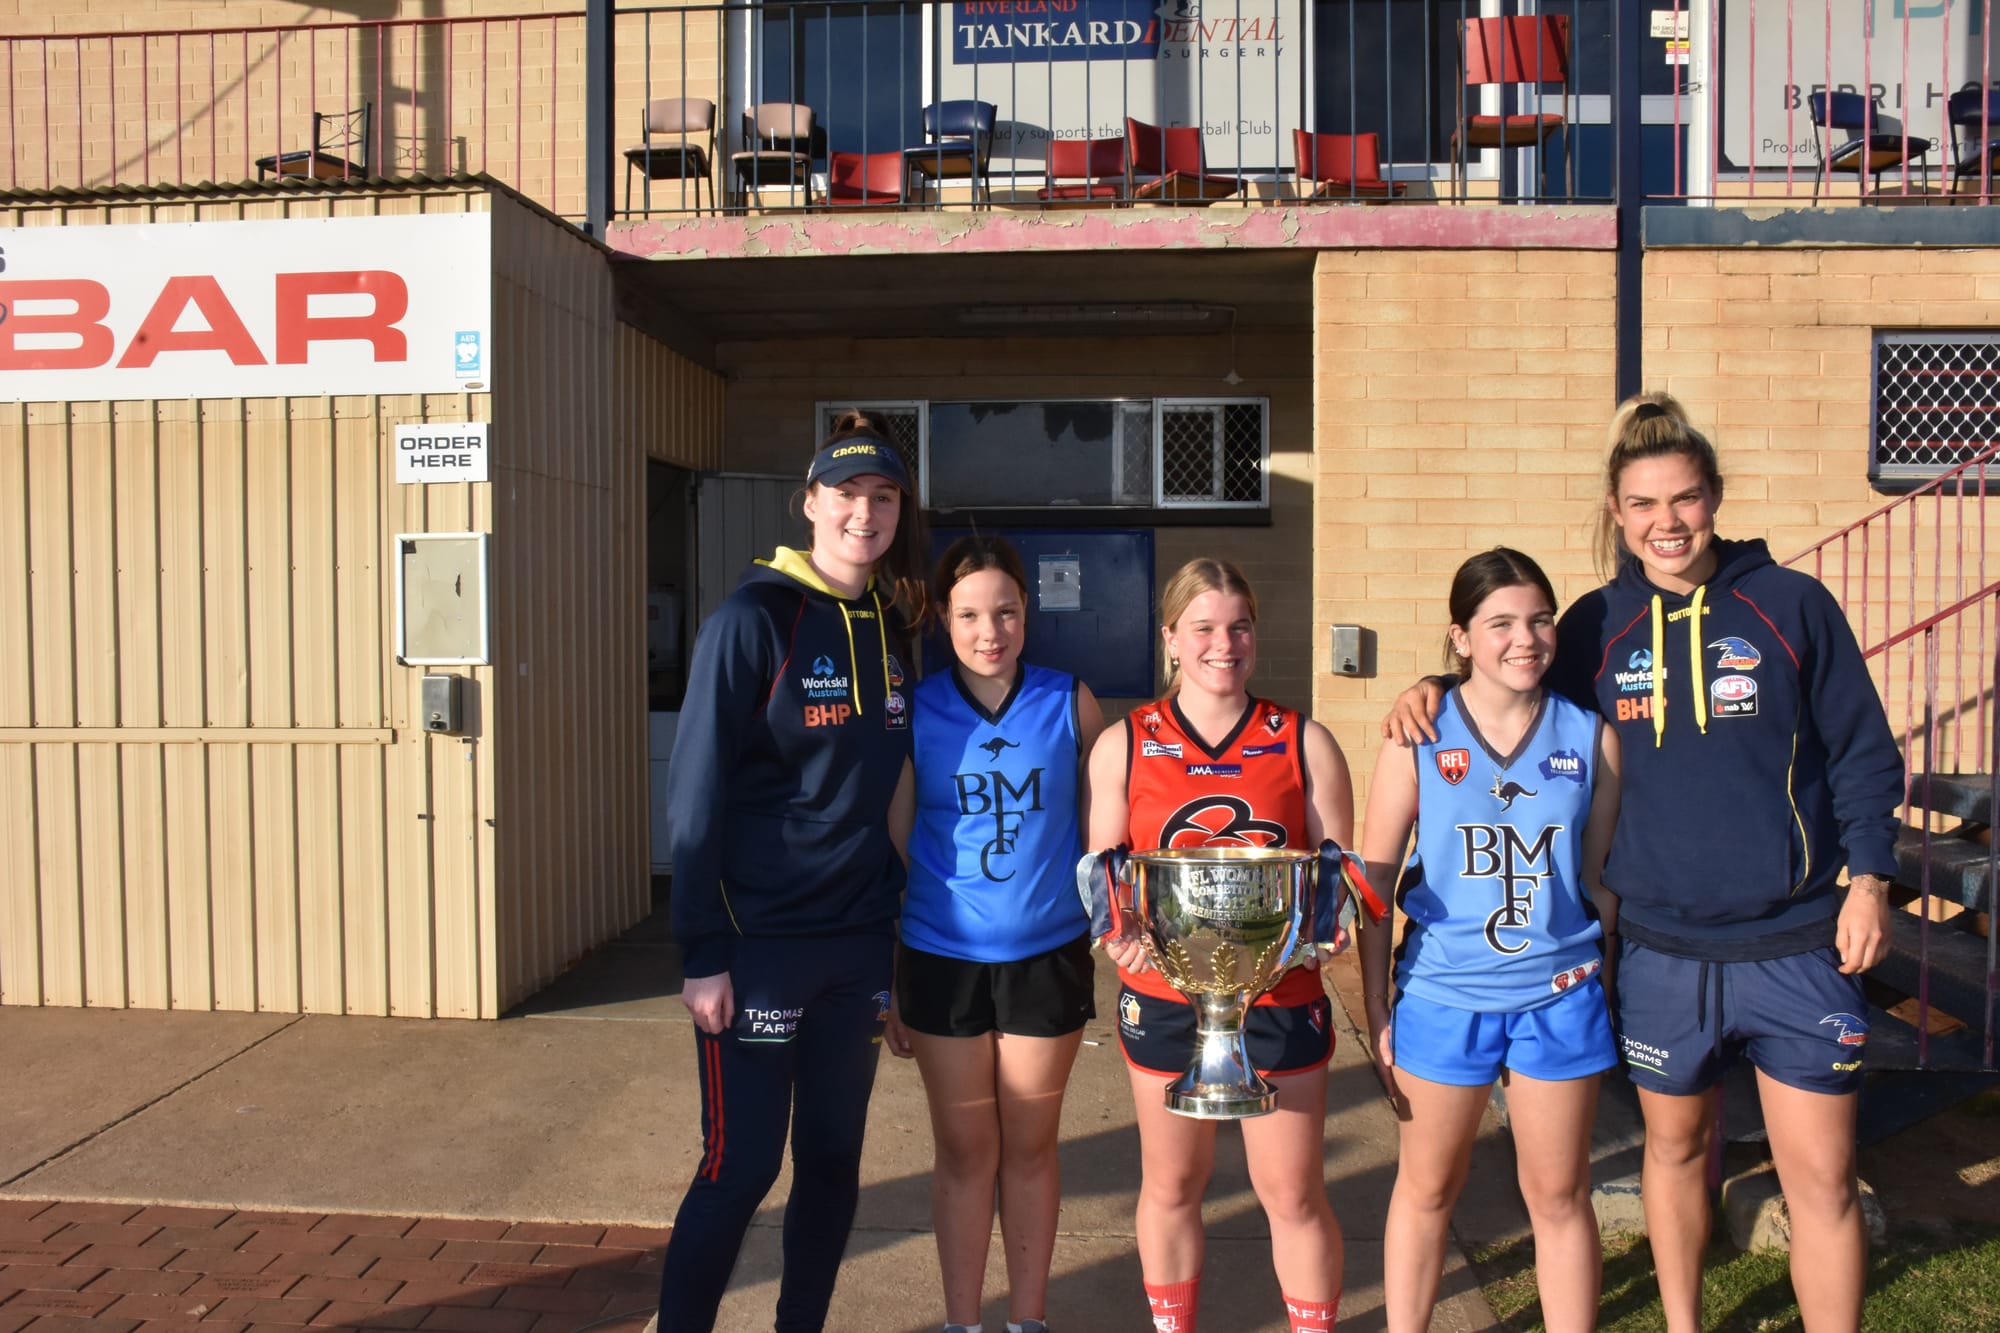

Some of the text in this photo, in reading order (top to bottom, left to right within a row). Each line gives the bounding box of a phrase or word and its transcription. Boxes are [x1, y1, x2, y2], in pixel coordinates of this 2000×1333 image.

[963, 0, 1078, 15] RIVERLAND
[958, 17, 1285, 49] TANKARD DENTAL
[1163, 47, 1285, 59] SURGERY
[1098, 123, 1123, 138] the
[1236, 120, 1272, 135] Club
[0, 270, 409, 371] BAR
[400, 436, 482, 451] ORDER
[832, 444, 877, 459] CROWS
[410, 454, 473, 468] HERE
[801, 676, 849, 690] Workskil
[1717, 681, 1753, 695] AFL
[807, 689, 848, 698] Australia
[1724, 704, 1740, 712] nab
[803, 703, 852, 728] BHP
[1441, 753, 1467, 767] RFL
[1549, 756, 1578, 770] WIN
[744, 1007, 804, 1021] THOMAS
[752, 1020, 798, 1034] FARMS
[1619, 1033, 1669, 1059] THOMAS
[1622, 1045, 1663, 1067] FARMS
